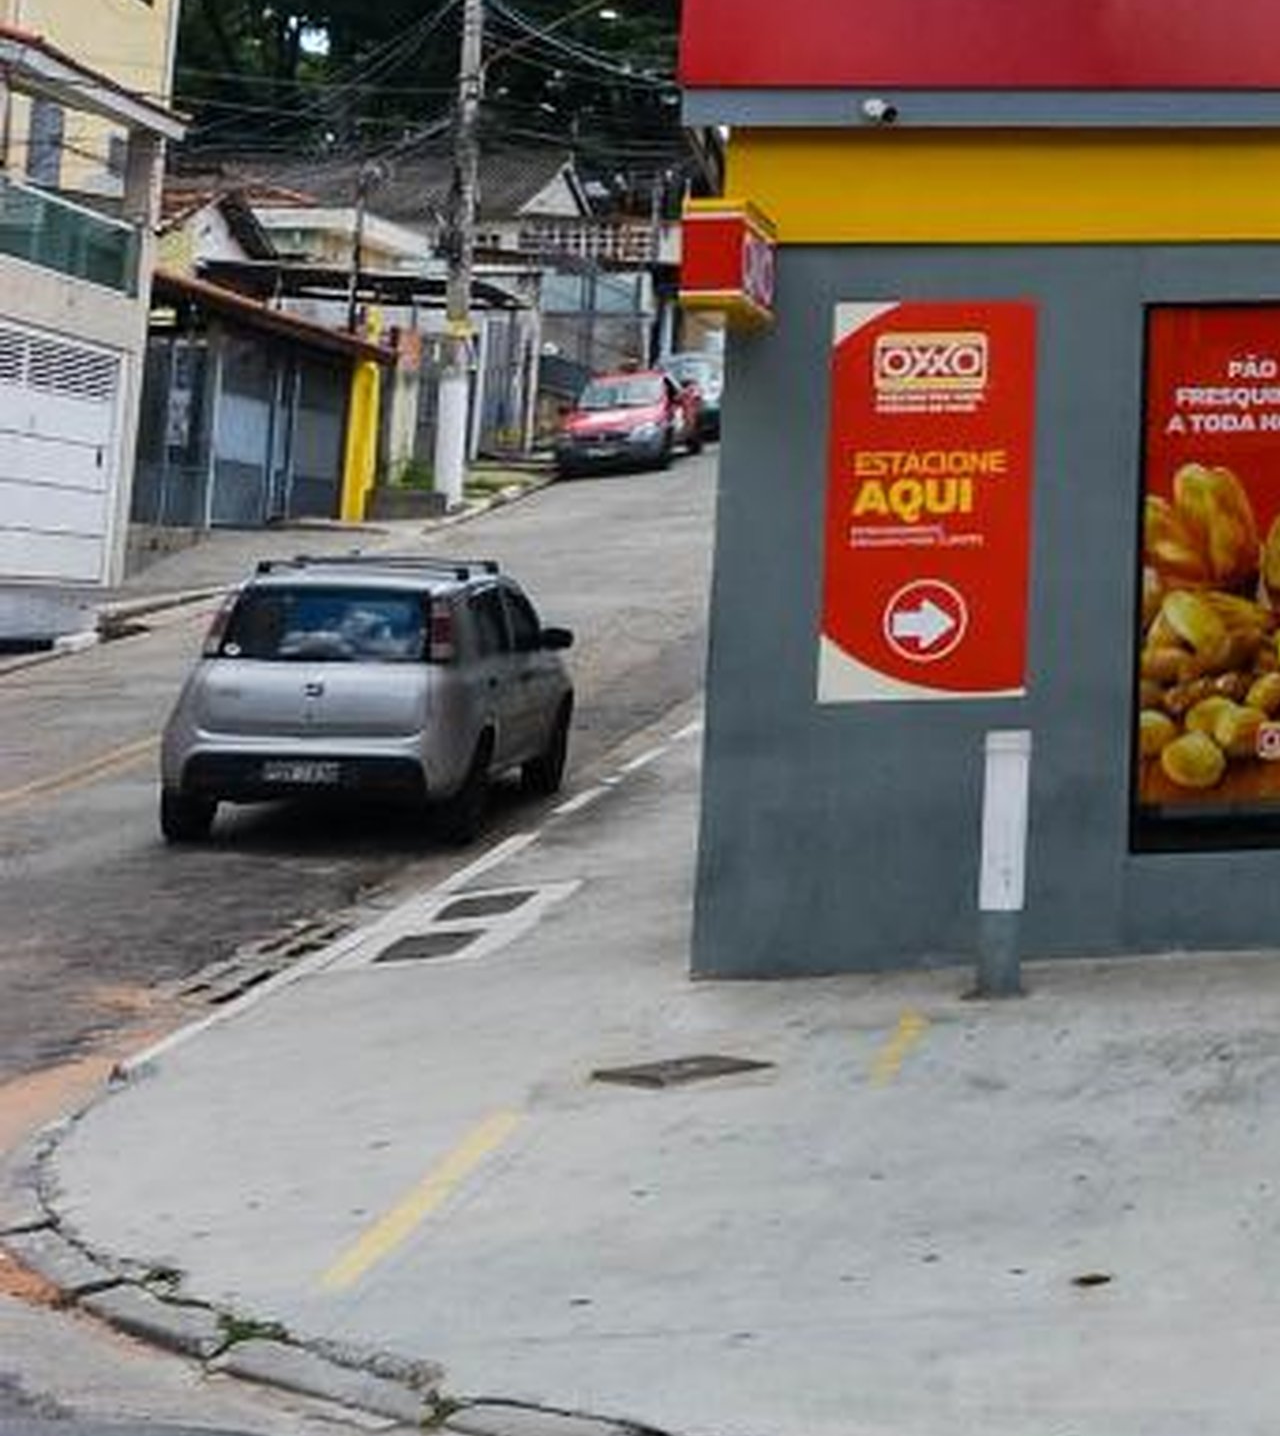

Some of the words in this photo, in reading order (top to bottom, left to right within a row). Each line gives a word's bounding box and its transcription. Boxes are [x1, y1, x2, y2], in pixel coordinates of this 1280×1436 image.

[883, 344, 981, 377] OXXO
[1228, 353, 1278, 379] PÃO
[1165, 414, 1186, 435] A
[1188, 413, 1255, 433] TODA
[854, 449, 1008, 476] ESTACIONE
[851, 477, 974, 524] AQUI
